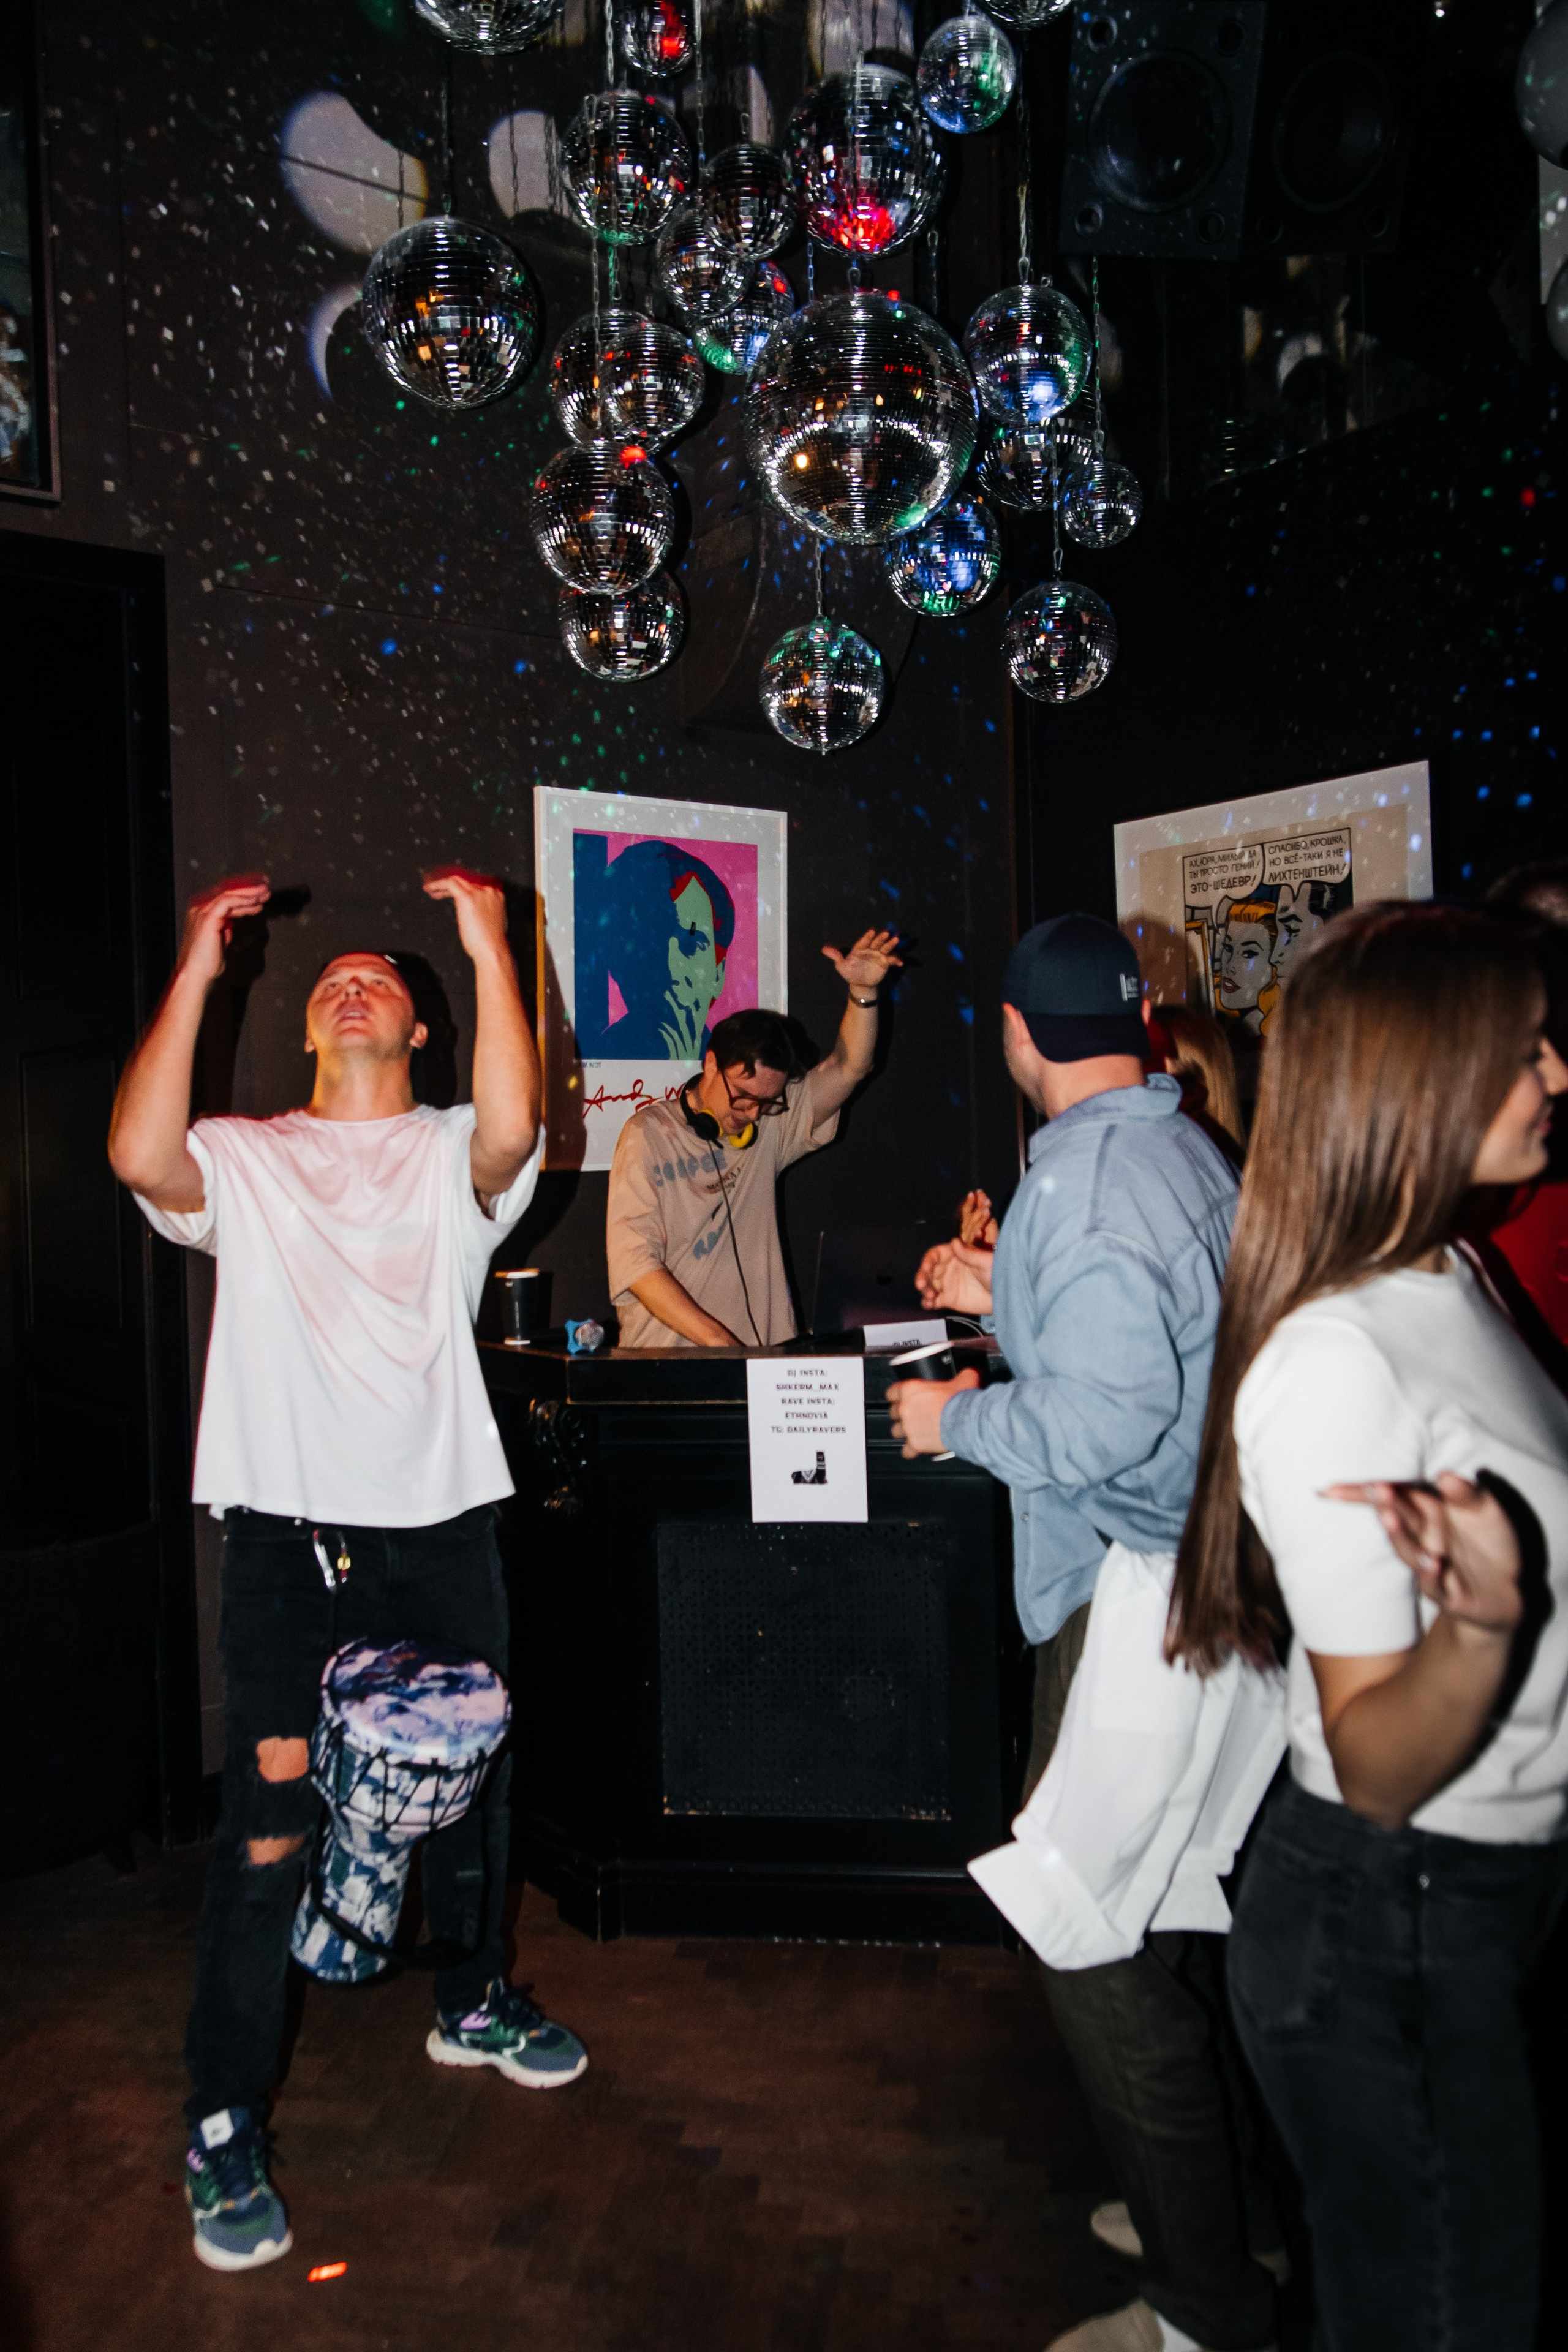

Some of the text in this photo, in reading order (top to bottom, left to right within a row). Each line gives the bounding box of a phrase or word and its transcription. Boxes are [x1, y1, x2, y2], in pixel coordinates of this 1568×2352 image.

[1268, 840, 1309, 854] СПАСИБО,
[1269, 858, 1281, 867] НО
[1326, 850, 1331, 859] Я
[1333, 848, 1344, 858] НЕ
[1189, 870, 1199, 879] ТЫ
[1200, 865, 1229, 876] ПРОСТО
[1268, 862, 1347, 883] ЛИХТЕНШТЕЙН!
